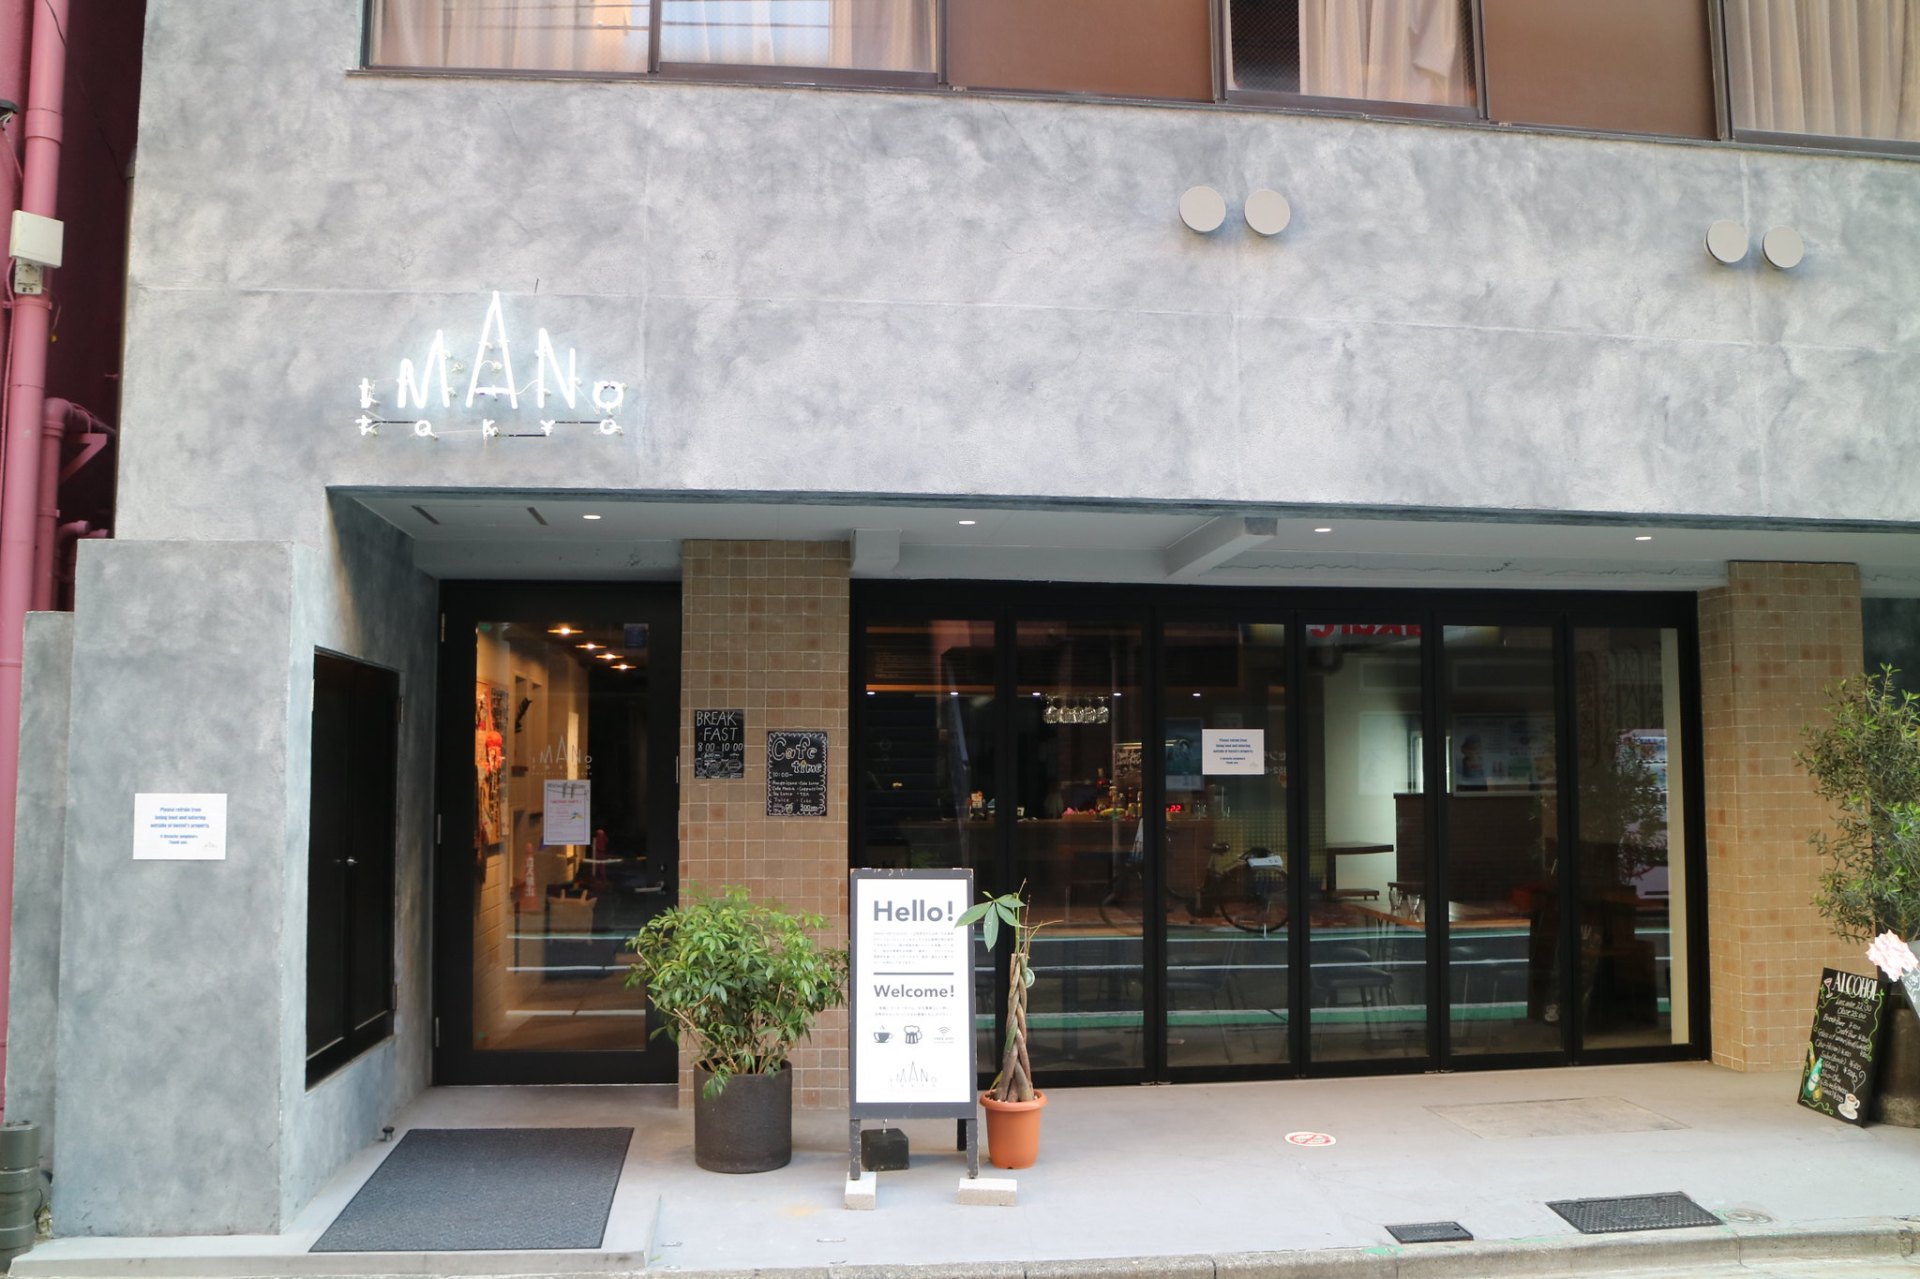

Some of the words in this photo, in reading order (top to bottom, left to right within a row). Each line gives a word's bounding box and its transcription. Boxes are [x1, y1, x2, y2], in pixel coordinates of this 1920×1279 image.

[696, 711, 737, 726] BREAK
[703, 727, 739, 742] FAST
[772, 736, 818, 761] Cafe
[791, 760, 823, 774] time
[873, 899, 954, 922] Hello!
[873, 984, 955, 998] Welcome!
[1831, 971, 1879, 1002] ALCOHOL
